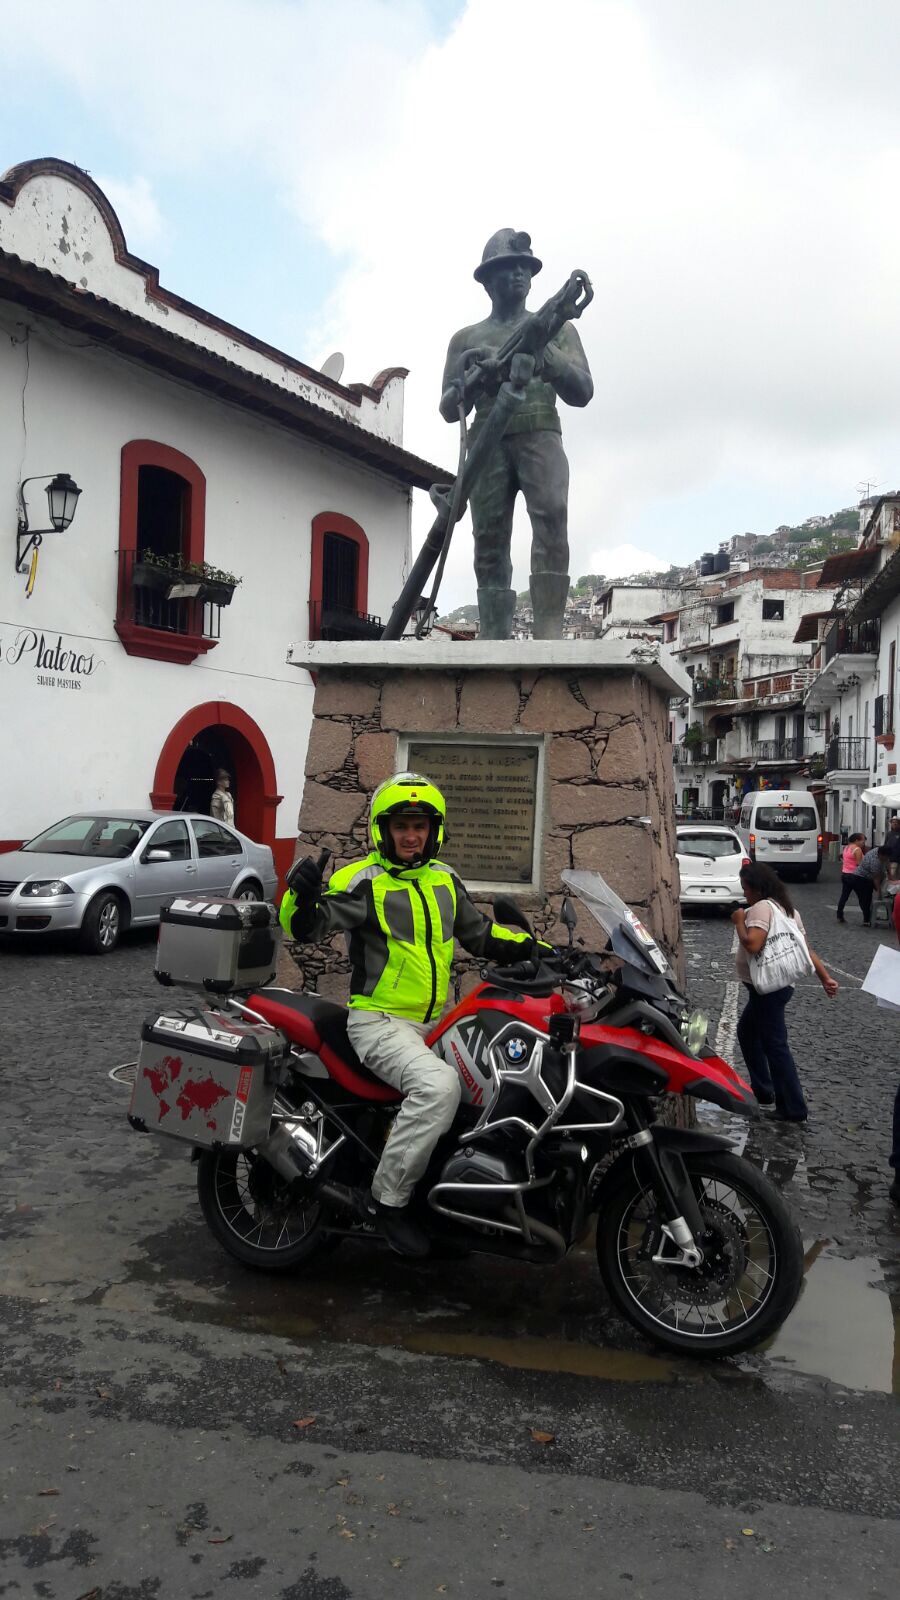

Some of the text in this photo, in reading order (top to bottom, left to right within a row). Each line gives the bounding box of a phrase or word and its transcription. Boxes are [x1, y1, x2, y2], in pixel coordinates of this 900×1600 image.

[6, 629, 106, 676] Plateros
[36, 675, 82, 690] SILVER MASTERS
[781, 794, 789, 802] 17
[774, 815, 798, 823] ZOCALO
[232, 1102, 243, 1138] ADV
